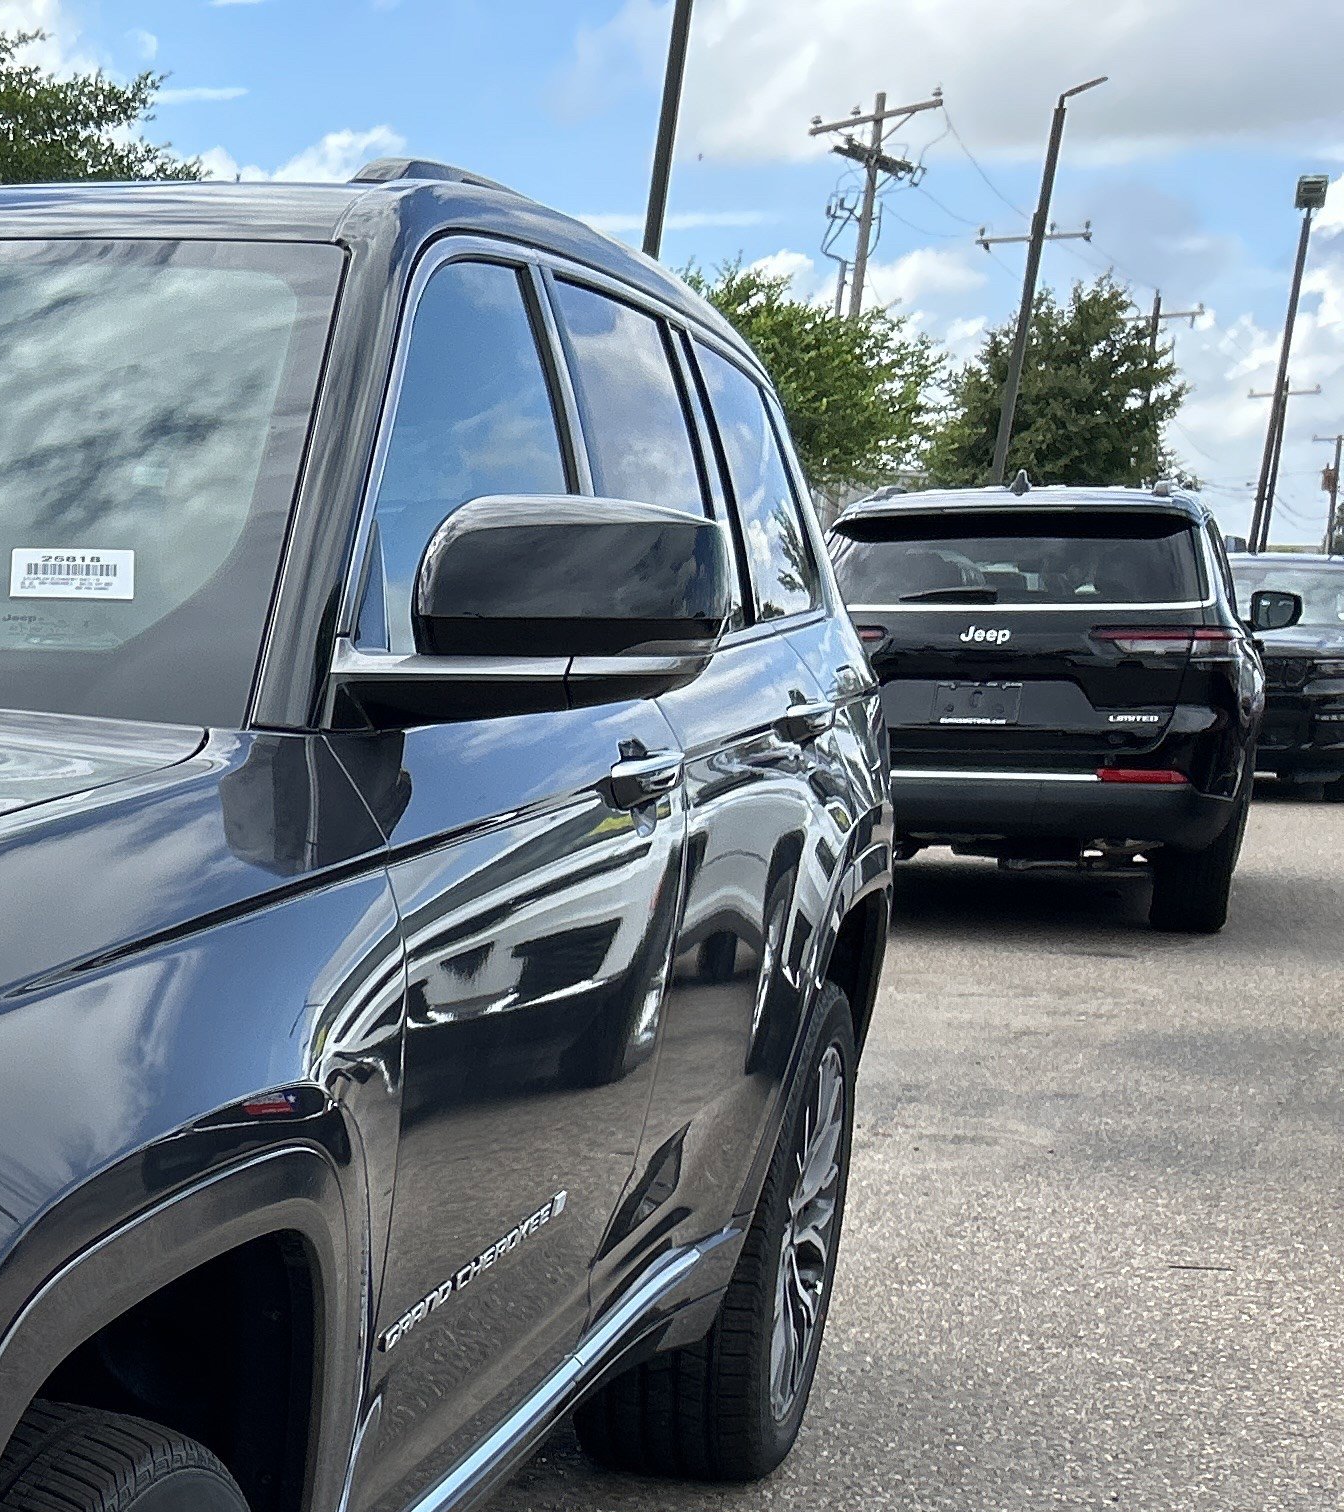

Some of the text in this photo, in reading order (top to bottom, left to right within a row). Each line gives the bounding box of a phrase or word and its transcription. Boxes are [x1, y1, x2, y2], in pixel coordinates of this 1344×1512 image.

[959, 625, 1011, 645] Jeep
[379, 1202, 553, 1353] GRAND CHEROKEE
